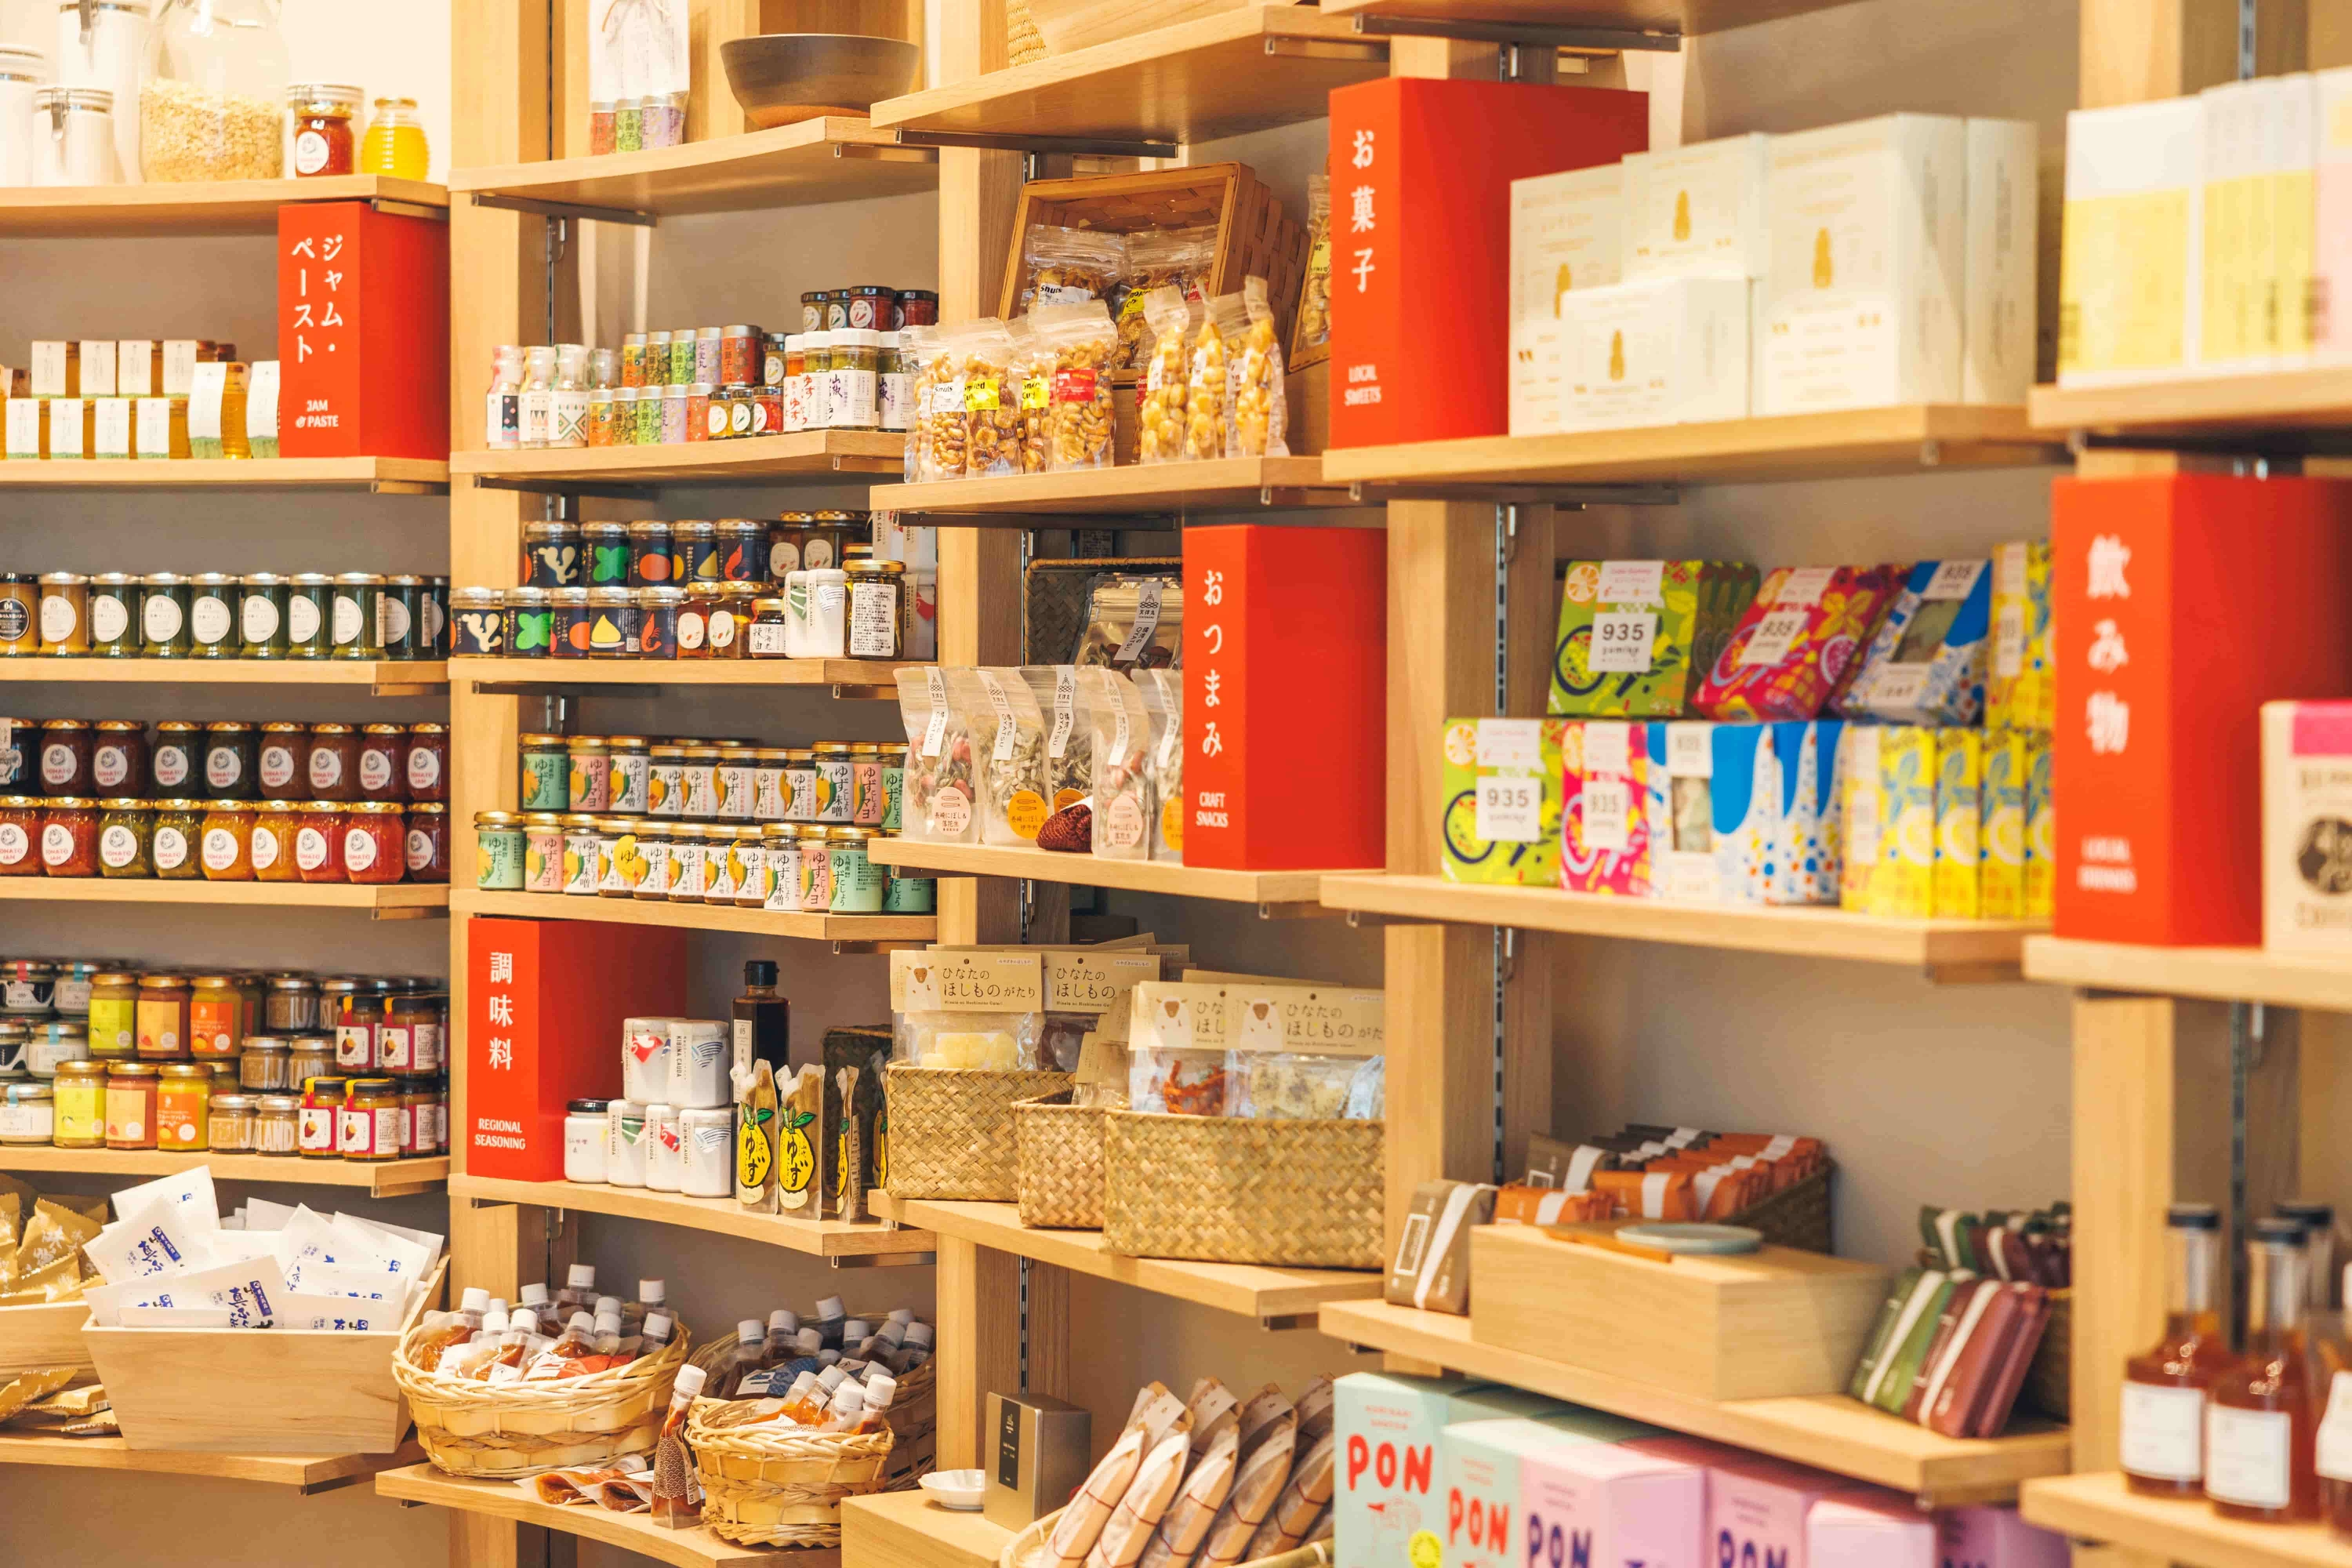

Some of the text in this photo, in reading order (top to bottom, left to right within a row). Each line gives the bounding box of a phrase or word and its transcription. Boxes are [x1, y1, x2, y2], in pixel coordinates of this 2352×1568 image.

[1351, 129, 1375, 293] お菓子
[291, 238, 315, 363] ペースト
[1348, 365, 1377, 383] LOCAL
[307, 400, 328, 412] JAM
[1345, 386, 1381, 406] SWEETS
[307, 416, 339, 427] PASTE
[1602, 623, 1645, 641] 935
[2087, 534, 2132, 754] 飲み物
[1203, 570, 1223, 757] おつまみ
[590, 759, 602, 782] ゆず
[629, 759, 642, 782] ゆず
[691, 771, 702, 794] ゆず
[834, 765, 848, 792] ゆず
[864, 767, 877, 793] ゆず
[728, 771, 739, 797] ゆず
[760, 772, 770, 798] ゆず
[794, 773, 806, 800] ゆず
[886, 774, 899, 804] ゆず
[862, 798, 870, 819] マヨ
[1199, 792, 1225, 808] CRAFT
[1487, 788, 1530, 808] 935
[1196, 811, 1229, 828] SNACKS
[488, 838, 502, 863] ゆず
[544, 838, 557, 862] ゆず
[583, 840, 597, 864] ゆず
[650, 848, 662, 872] ゆず
[683, 850, 695, 874] ゆず
[746, 852, 760, 877] ゆず
[777, 855, 790, 880] ゆず
[813, 852, 826, 880] ゆず
[833, 856, 845, 887] ゆず
[810, 884, 818, 905] マヨ
[942, 967, 990, 980] ひなたの
[1057, 967, 1105, 981] ひなたの
[1057, 983, 1117, 1000] ほしもの
[489, 952, 513, 1071] 調味料
[1196, 1002, 1225, 1014] ひな
[1287, 1004, 1342, 1018] ひなたの
[1287, 1022, 1383, 1039] ほしものがた
[478, 1118, 522, 1134] REGIONAL
[475, 1134, 525, 1150] SEASONING
[745, 1136, 765, 1182] ゆず
[786, 1136, 809, 1187] ゆず
[1348, 1433, 1433, 1495] PON
[1447, 1487, 1510, 1555] PON
[1528, 1513, 1592, 1568] PON
